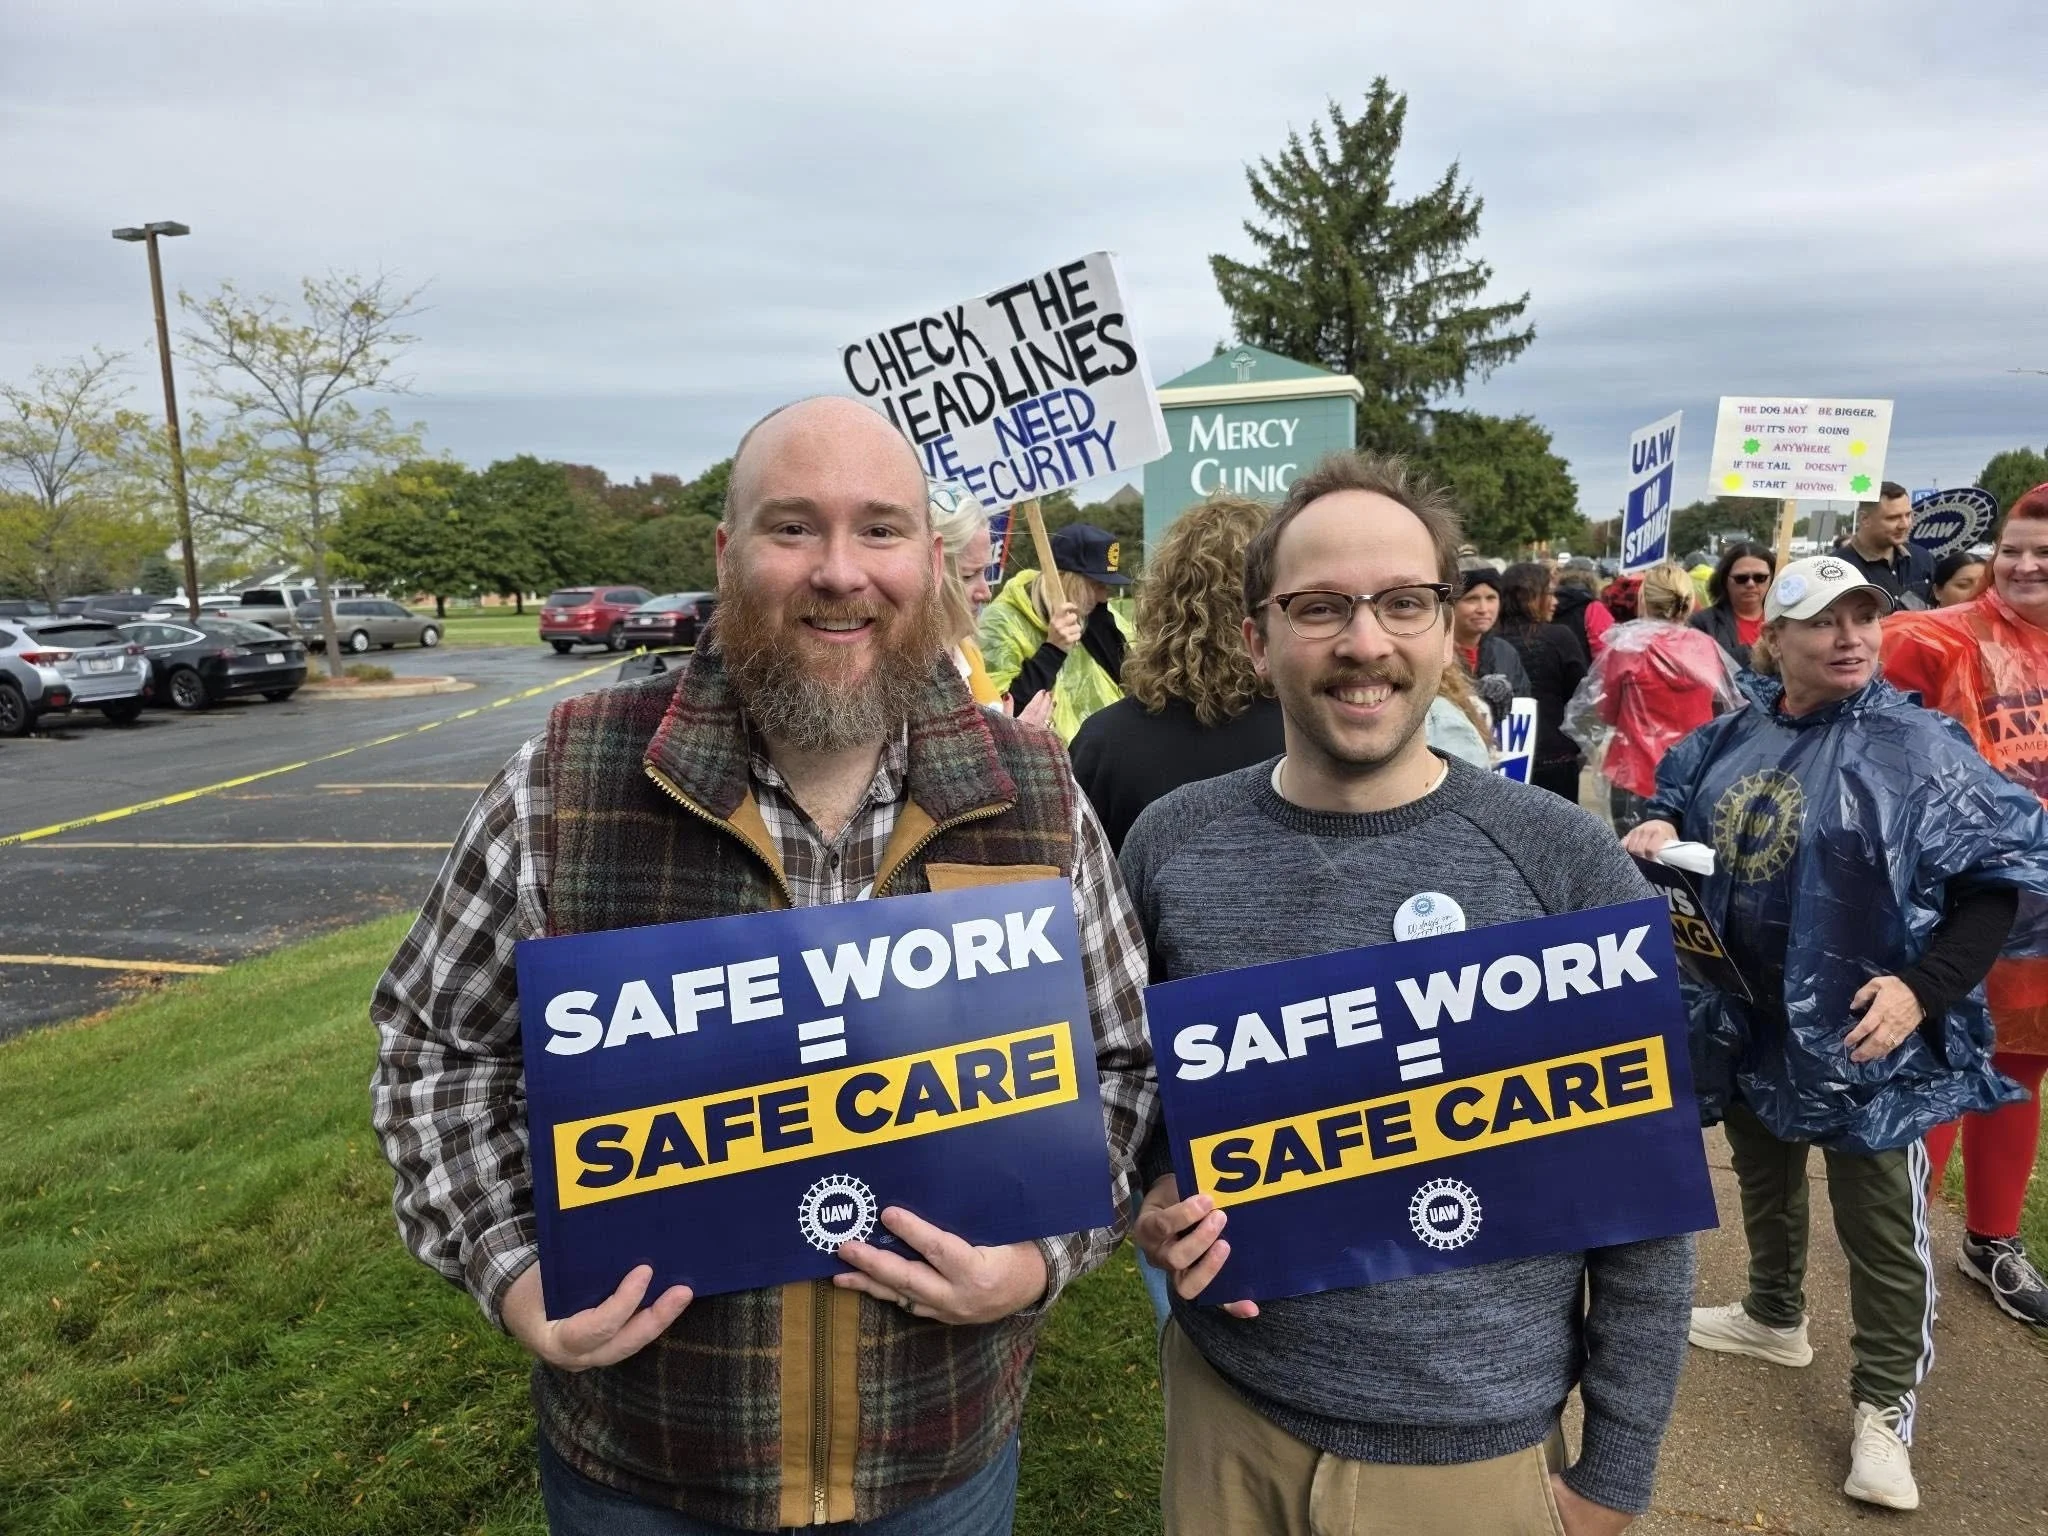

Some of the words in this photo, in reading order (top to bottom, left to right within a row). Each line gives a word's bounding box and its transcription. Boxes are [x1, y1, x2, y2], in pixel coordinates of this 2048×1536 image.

[843, 305, 988, 397] CHECK
[986, 260, 1098, 342] THE
[992, 387, 1096, 458] NEED
[1738, 406, 1757, 414] THE
[1760, 406, 1780, 415] DOG
[1818, 407, 1832, 416] BE
[1744, 425, 1764, 433] BUT
[1767, 425, 1785, 433] IT'S
[1788, 425, 1808, 434] NOT
[1818, 426, 1850, 435] GOING
[1188, 413, 1300, 452] MERCY
[1632, 425, 1676, 475] UAW
[1773, 443, 1831, 454] ANYWHERE
[950, 420, 1117, 506] ECURITY
[1733, 460, 1743, 469] IF
[1745, 461, 1764, 469] THE
[1768, 461, 1791, 471] TAIL
[1805, 462, 1847, 472] DOESN'T
[1642, 477, 1661, 520] ON
[1752, 480, 1787, 489] START
[1625, 501, 1669, 564] STRIKE
[1913, 521, 1961, 539] UAW
[1489, 713, 1531, 752] AW
[544, 956, 784, 1056] SAFE
[801, 905, 1063, 1007] WORK
[1173, 986, 1383, 1081] SAFE
[1395, 924, 1657, 1031] WORK
[574, 1085, 814, 1189] SAFE
[835, 1033, 1062, 1135] CARE
[1210, 1099, 1418, 1194] SAFE
[1435, 1047, 1654, 1142] CARE
[821, 1203, 853, 1223] UAW
[1429, 1203, 1459, 1223] UAW
